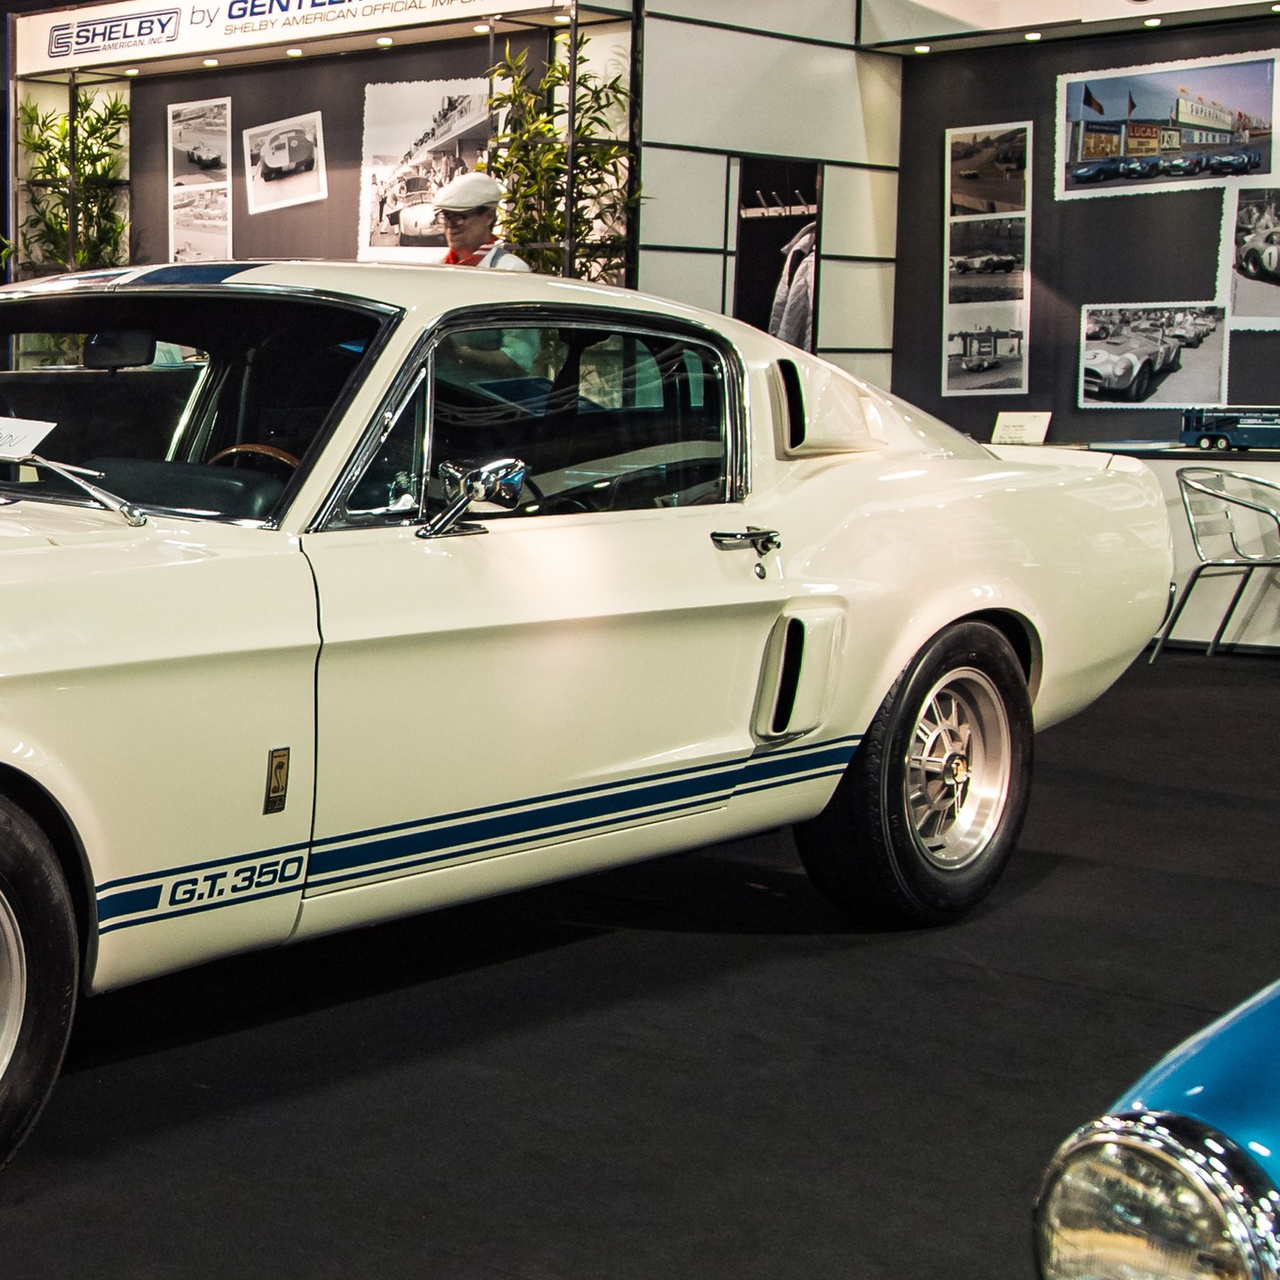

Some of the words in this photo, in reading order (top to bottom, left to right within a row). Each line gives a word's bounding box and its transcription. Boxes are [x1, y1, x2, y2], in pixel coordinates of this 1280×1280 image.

[74, 15, 174, 46] SHELBY
[189, 6, 220, 28] by
[224, 19, 278, 36] SHELBY
[282, 7, 358, 27] AMERICAN
[1129, 125, 1157, 138] LUCAS
